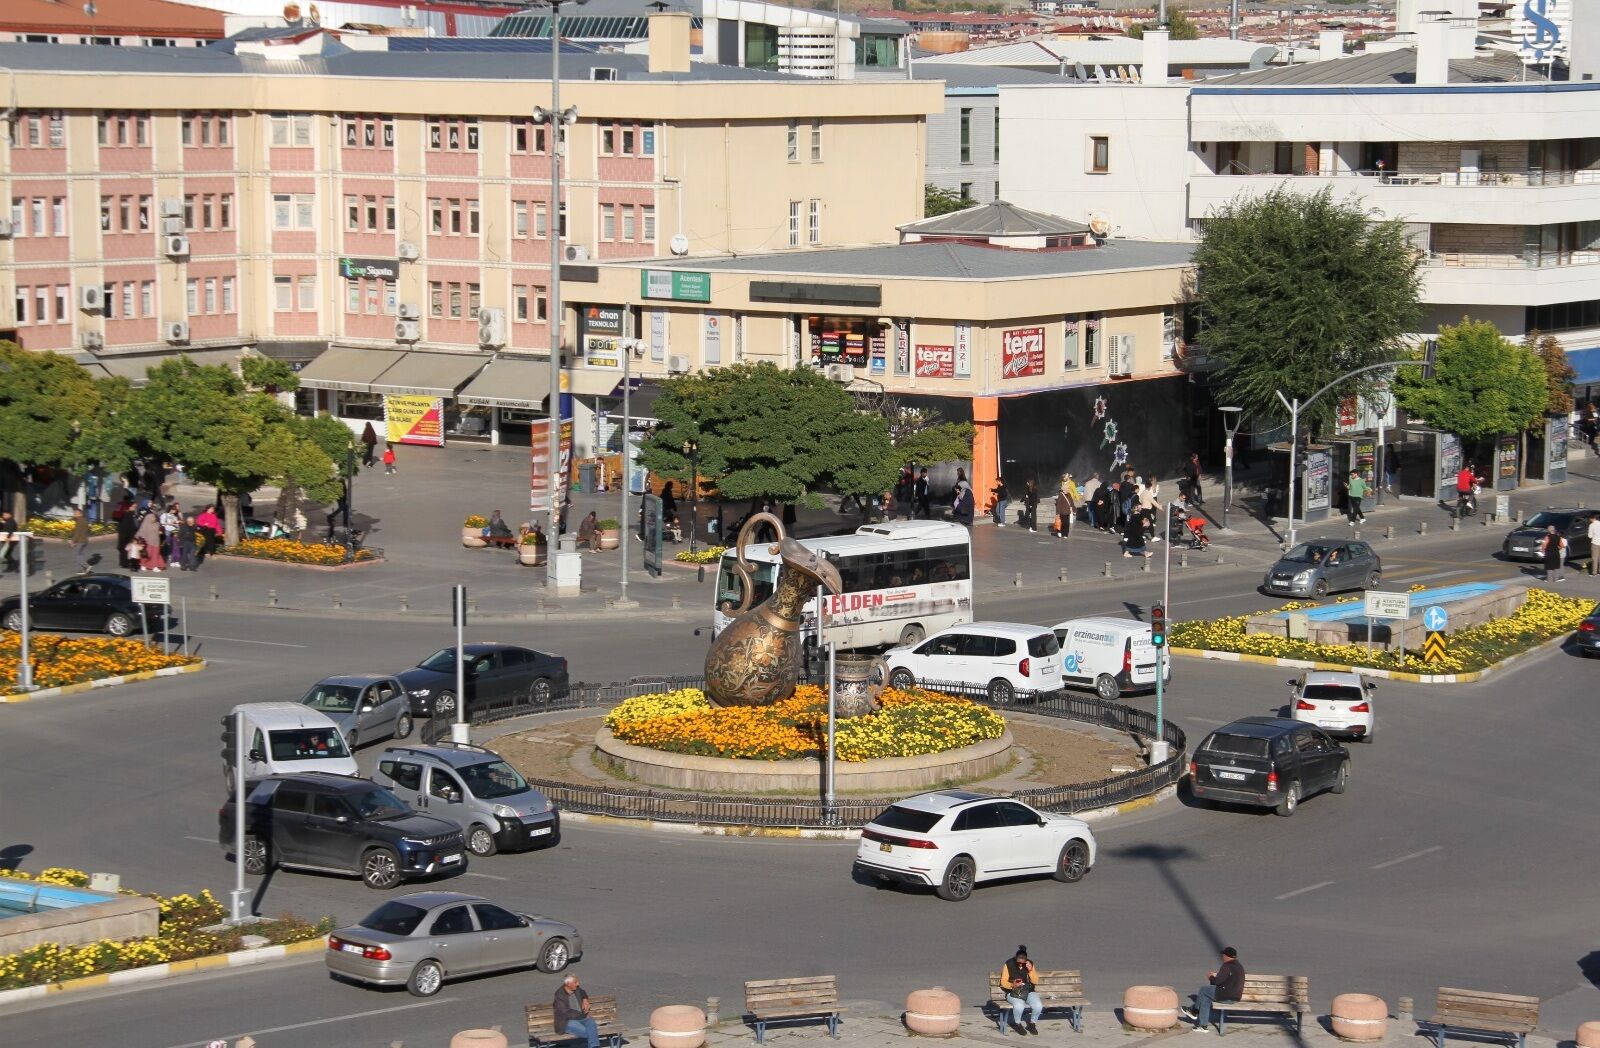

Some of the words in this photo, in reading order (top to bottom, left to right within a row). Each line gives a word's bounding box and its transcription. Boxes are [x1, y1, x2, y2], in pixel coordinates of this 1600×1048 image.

[588, 306, 619, 319] Adnan
[1004, 328, 1043, 355] terzi
[917, 346, 953, 362] terzi
[831, 593, 883, 615] ELDEN
